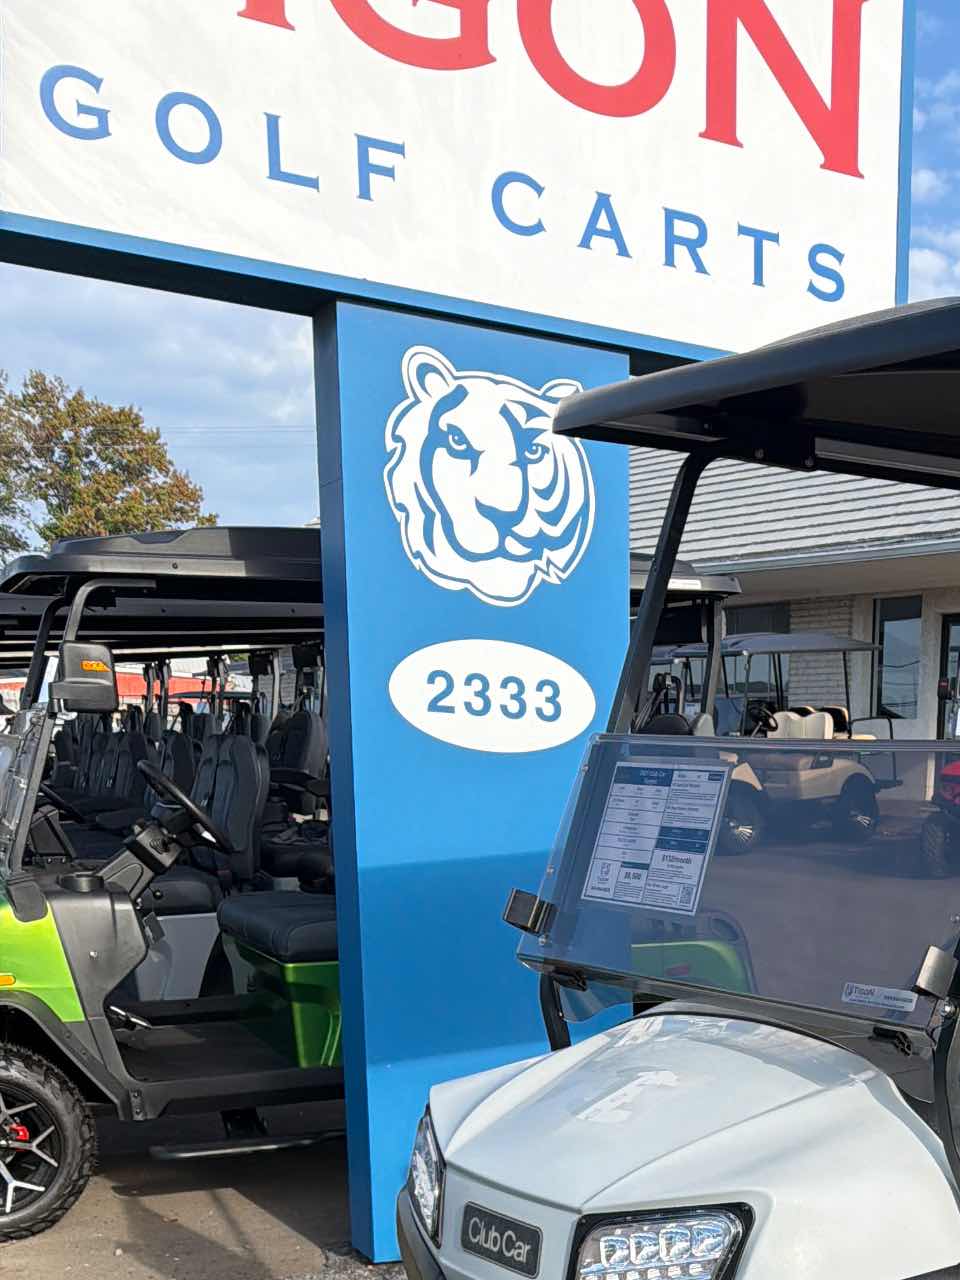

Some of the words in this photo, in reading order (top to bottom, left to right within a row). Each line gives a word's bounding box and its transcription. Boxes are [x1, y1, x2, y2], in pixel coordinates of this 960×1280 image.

[39, 65, 406, 201] GOLF
[490, 170, 847, 303] CARTS
[426, 669, 562, 723] 2333
[468, 1216, 500, 1252] Club
[502, 1229, 532, 1264] Car
